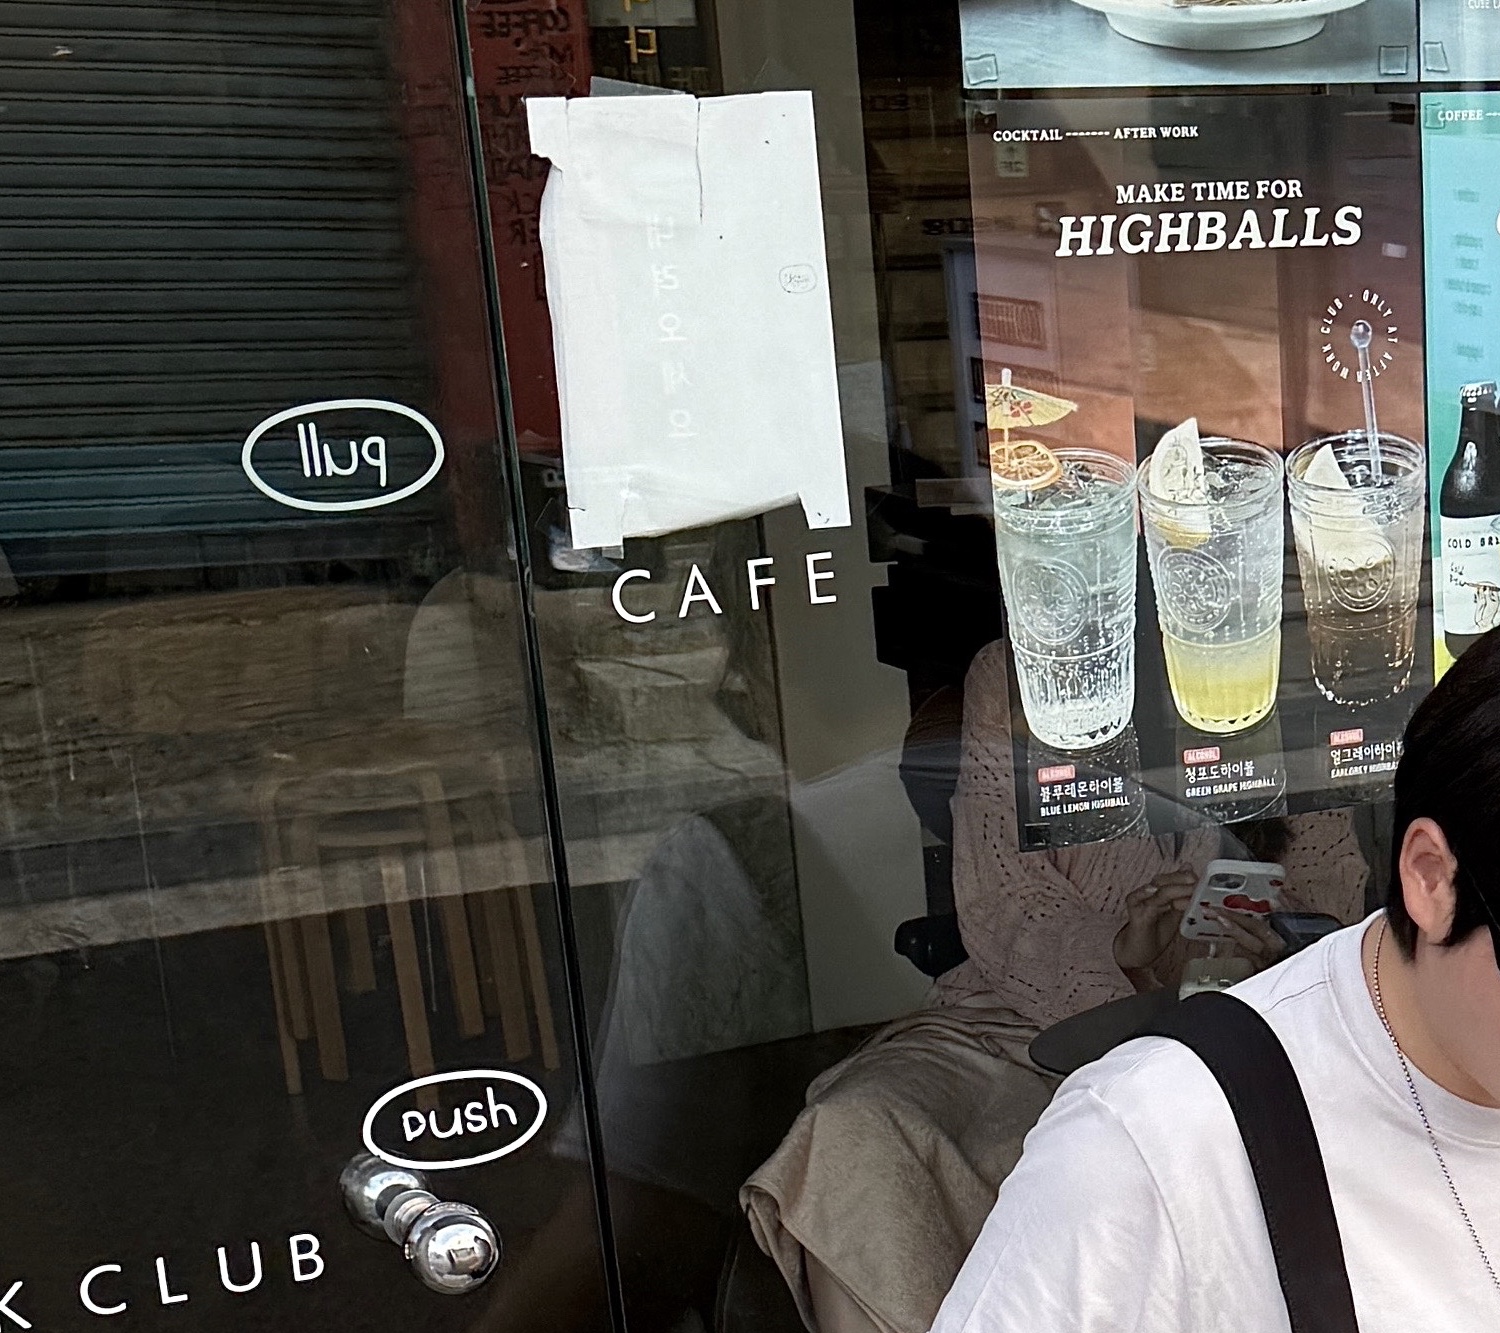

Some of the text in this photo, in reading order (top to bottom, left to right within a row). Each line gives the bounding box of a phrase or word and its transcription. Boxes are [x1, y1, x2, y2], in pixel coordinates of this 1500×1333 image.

[1438, 109, 1483, 121] COFFEE
[993, 125, 1199, 142] COCKTAIL AFTER WORK
[1116, 179, 1303, 204] MAKE TIME FOR
[1054, 205, 1363, 257] HIGHBALLS
[1320, 297, 1344, 334] CLUB
[1362, 289, 1393, 318] ONLY
[1387, 326, 1399, 343] AT
[611, 551, 838, 624] CAFE
[1185, 760, 1255, 784] 청포도하이볼
[1186, 786, 1211, 797] GREEN
[1213, 782, 1238, 794] GRAPE
[1040, 805, 1061, 817] BLUE
[1063, 801, 1090, 813] LEMON
[402, 1087, 517, 1140] push
[79, 1233, 325, 1315] CLUB
